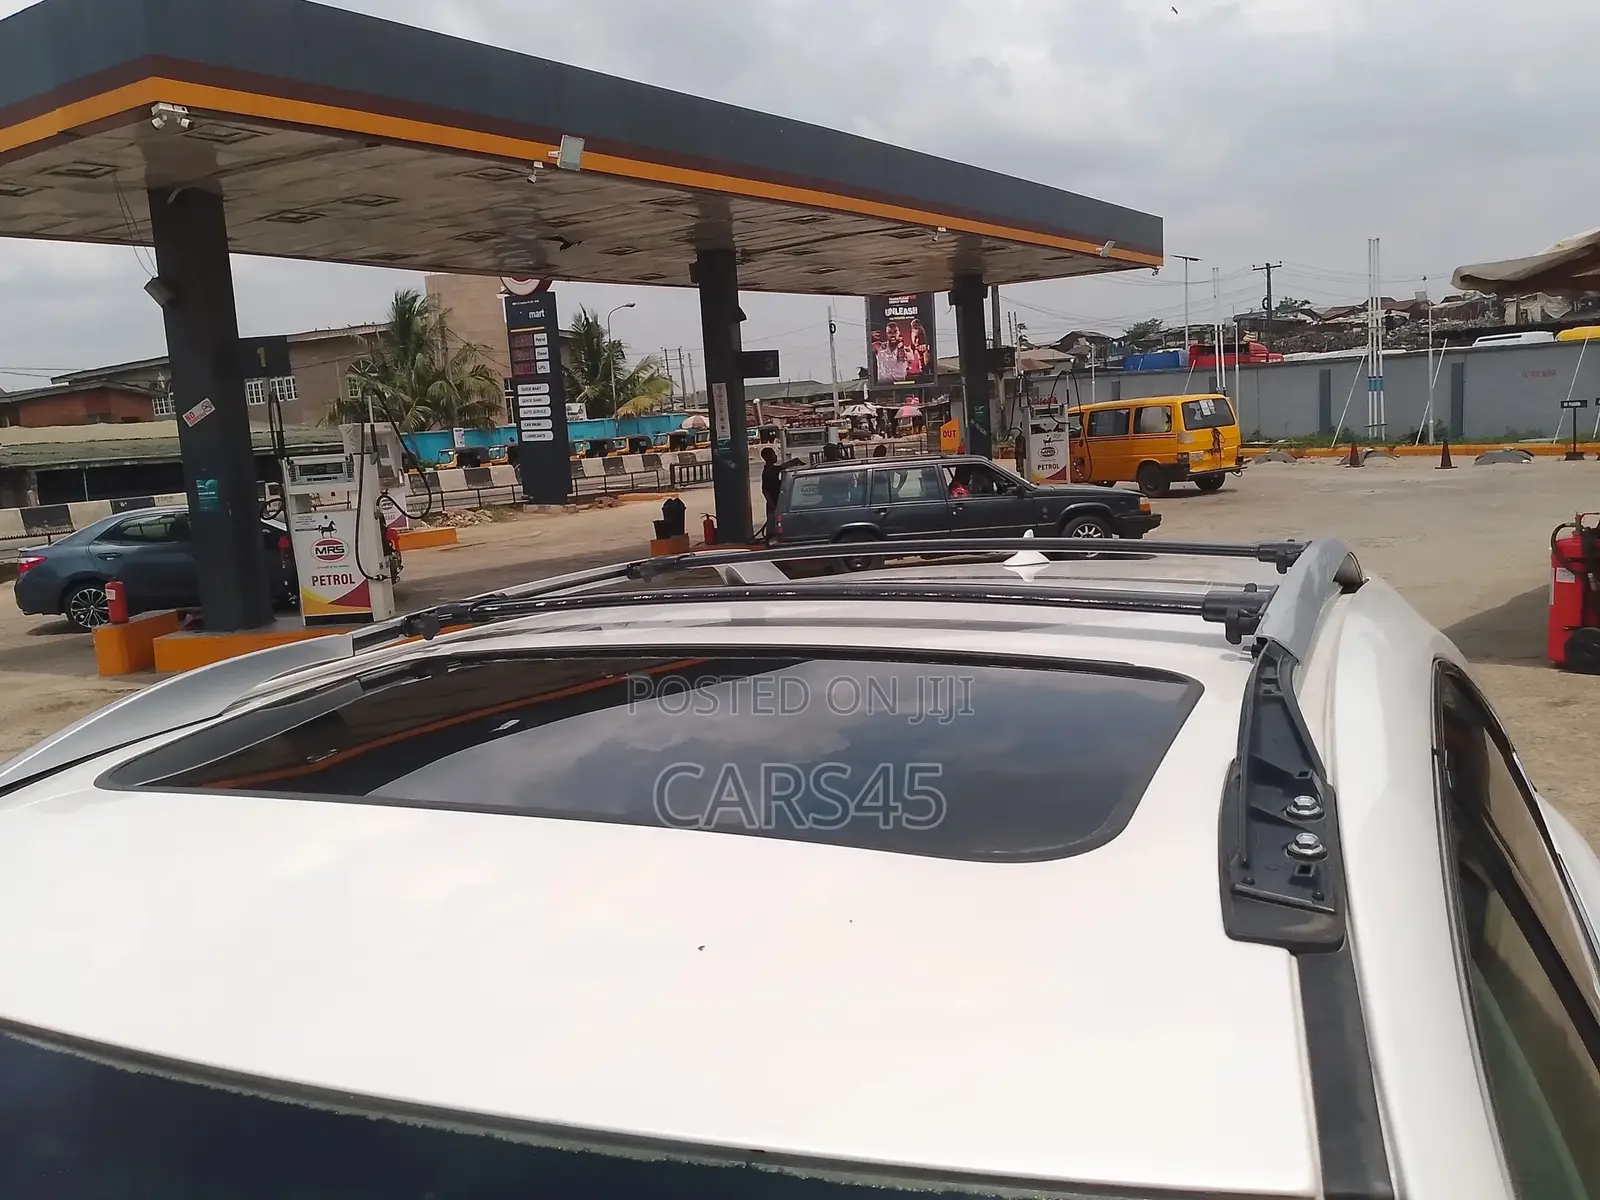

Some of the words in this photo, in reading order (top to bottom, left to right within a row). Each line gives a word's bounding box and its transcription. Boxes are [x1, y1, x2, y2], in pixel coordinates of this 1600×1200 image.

[528, 309, 545, 319] mart
[884, 306, 918, 316] UNLEASH
[256, 346, 267, 368] 1
[184, 411, 196, 422] NO
[942, 430, 956, 438] OUT
[315, 545, 345, 555] MRS
[311, 573, 355, 586] PETROL
